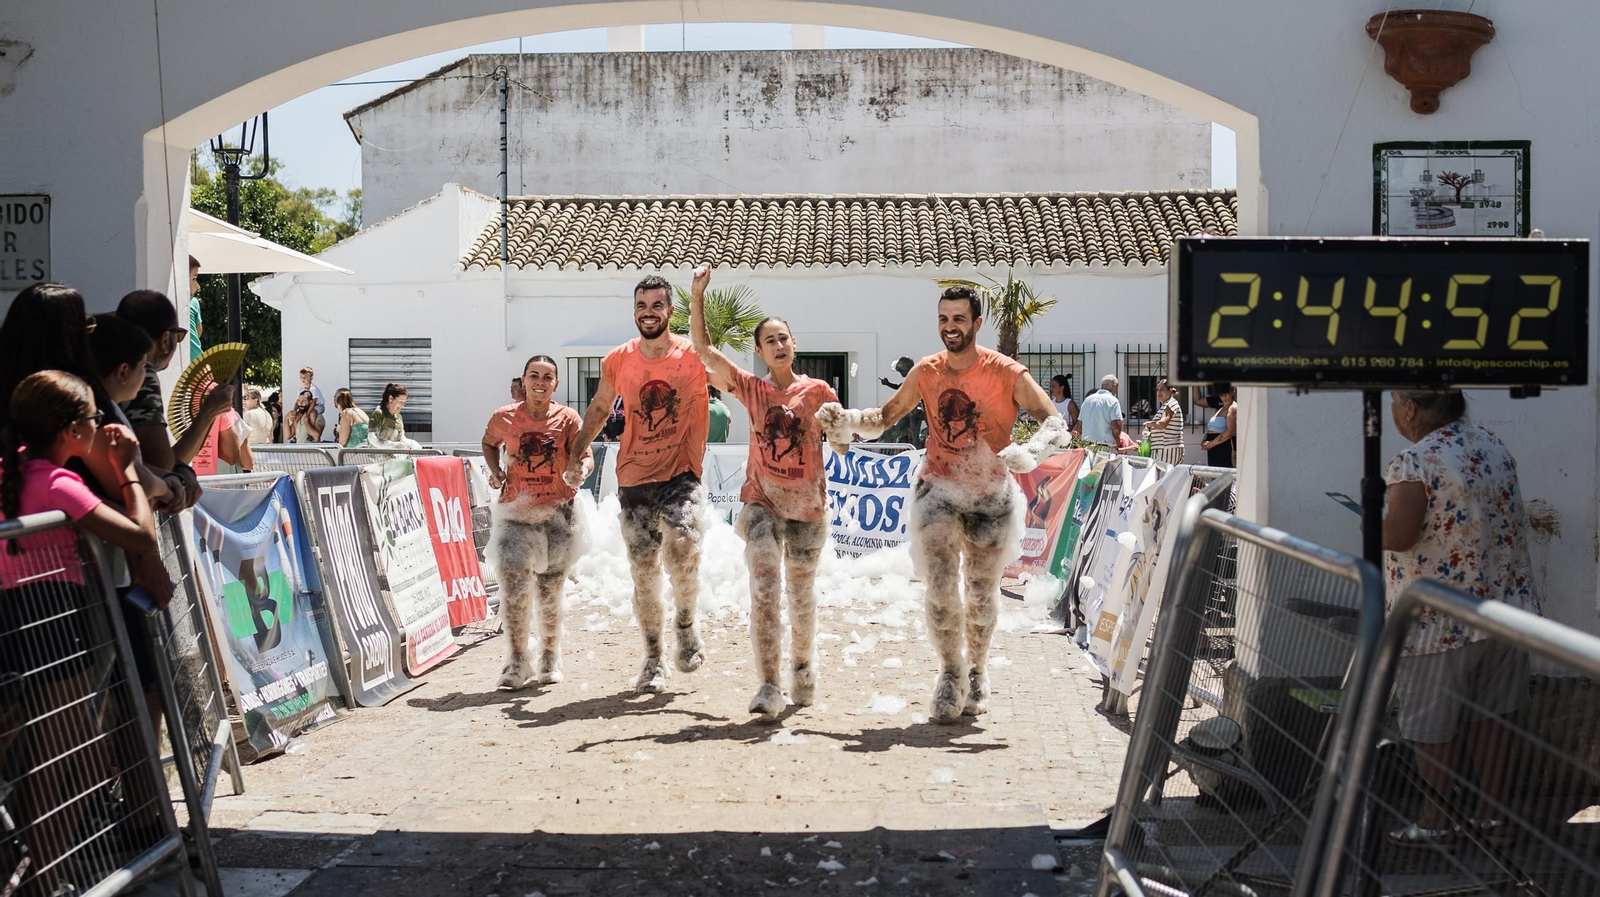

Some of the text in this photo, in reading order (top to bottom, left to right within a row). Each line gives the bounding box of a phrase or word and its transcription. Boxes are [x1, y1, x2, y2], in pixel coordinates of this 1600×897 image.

[0, 203, 44, 225] IDO
[1207, 273, 1561, 349] 2:44:52
[1197, 356, 1329, 366] www.gesconchip.es
[1341, 356, 1366, 367] 615
[1400, 357, 1423, 367] 784
[1436, 357, 1569, 368] info@gesconchip.es
